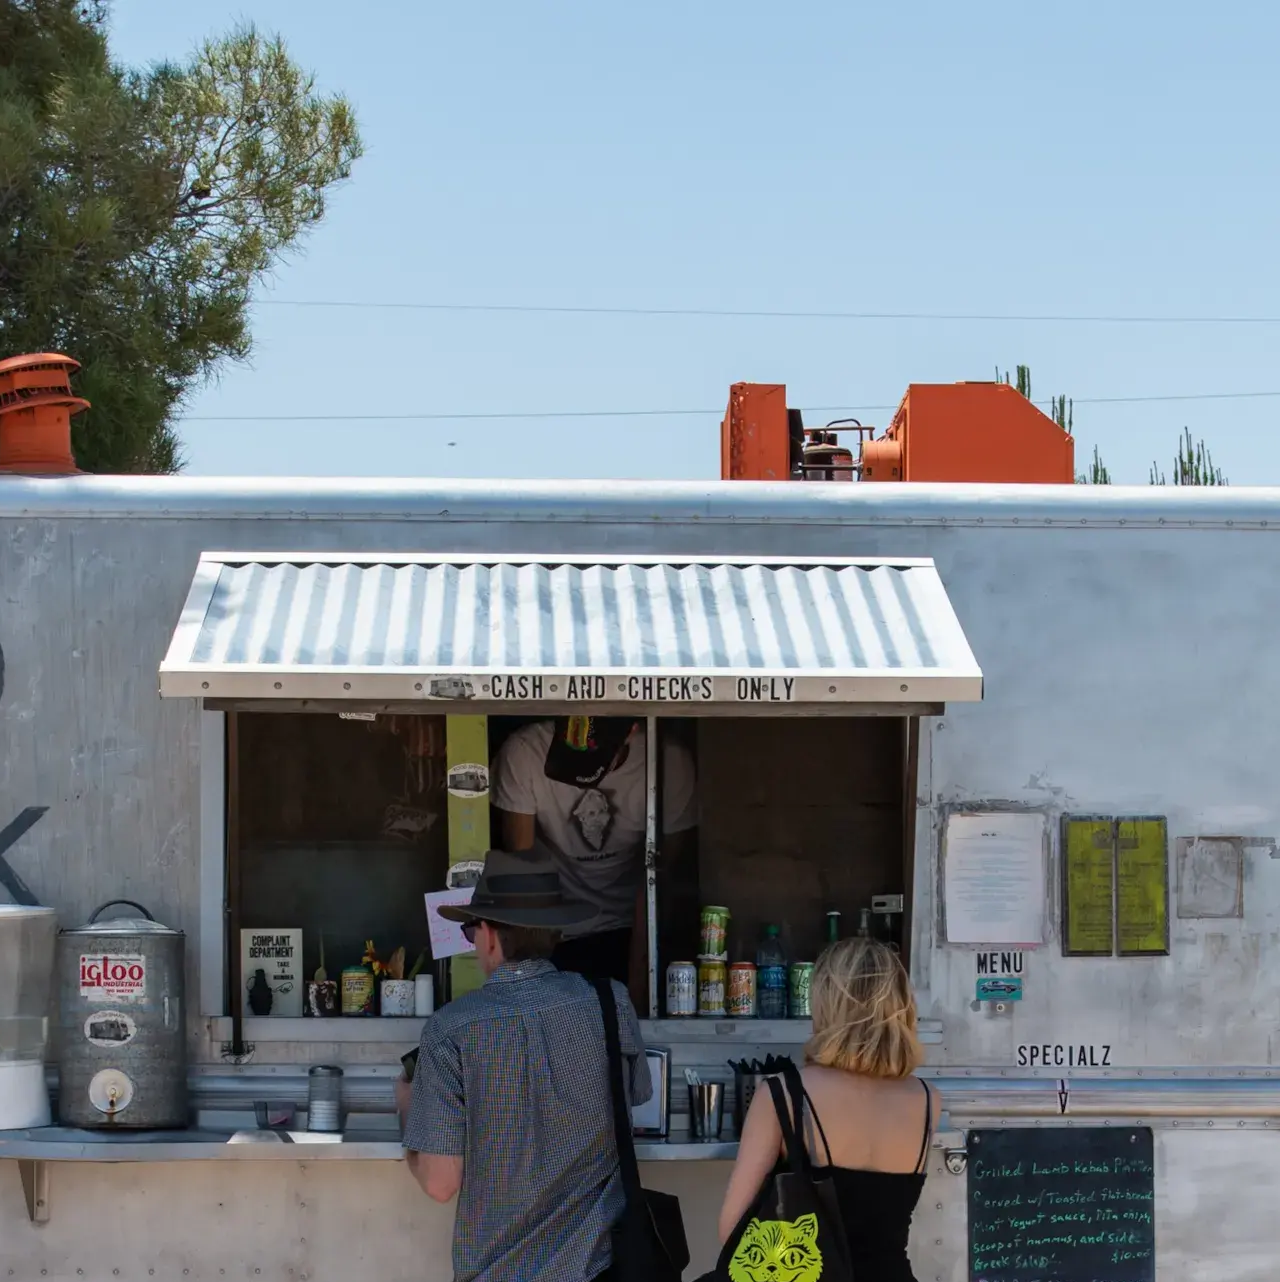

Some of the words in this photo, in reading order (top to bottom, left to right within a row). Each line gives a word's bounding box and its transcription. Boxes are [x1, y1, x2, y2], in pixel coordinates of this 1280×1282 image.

[491, 675, 543, 699] CASH
[567, 676, 606, 699] AND
[628, 677, 712, 700] CHECKS
[737, 677, 795, 701] ONLY
[252, 935, 291, 947] COMPLAINT
[249, 947, 293, 958] DEPARTMENT
[81, 956, 144, 986] igloo
[977, 952, 1023, 974] MENU
[1017, 1045, 1111, 1066] SPECIALZ
[975, 1160, 1024, 1179] Grilled
[1033, 1162, 1070, 1175] Lamb
[1074, 1161, 1109, 1173] Kebab
[1008, 1212, 1047, 1230] Yogurt
[1079, 1232, 1105, 1244] and
[974, 1256, 1010, 1271] Greek
